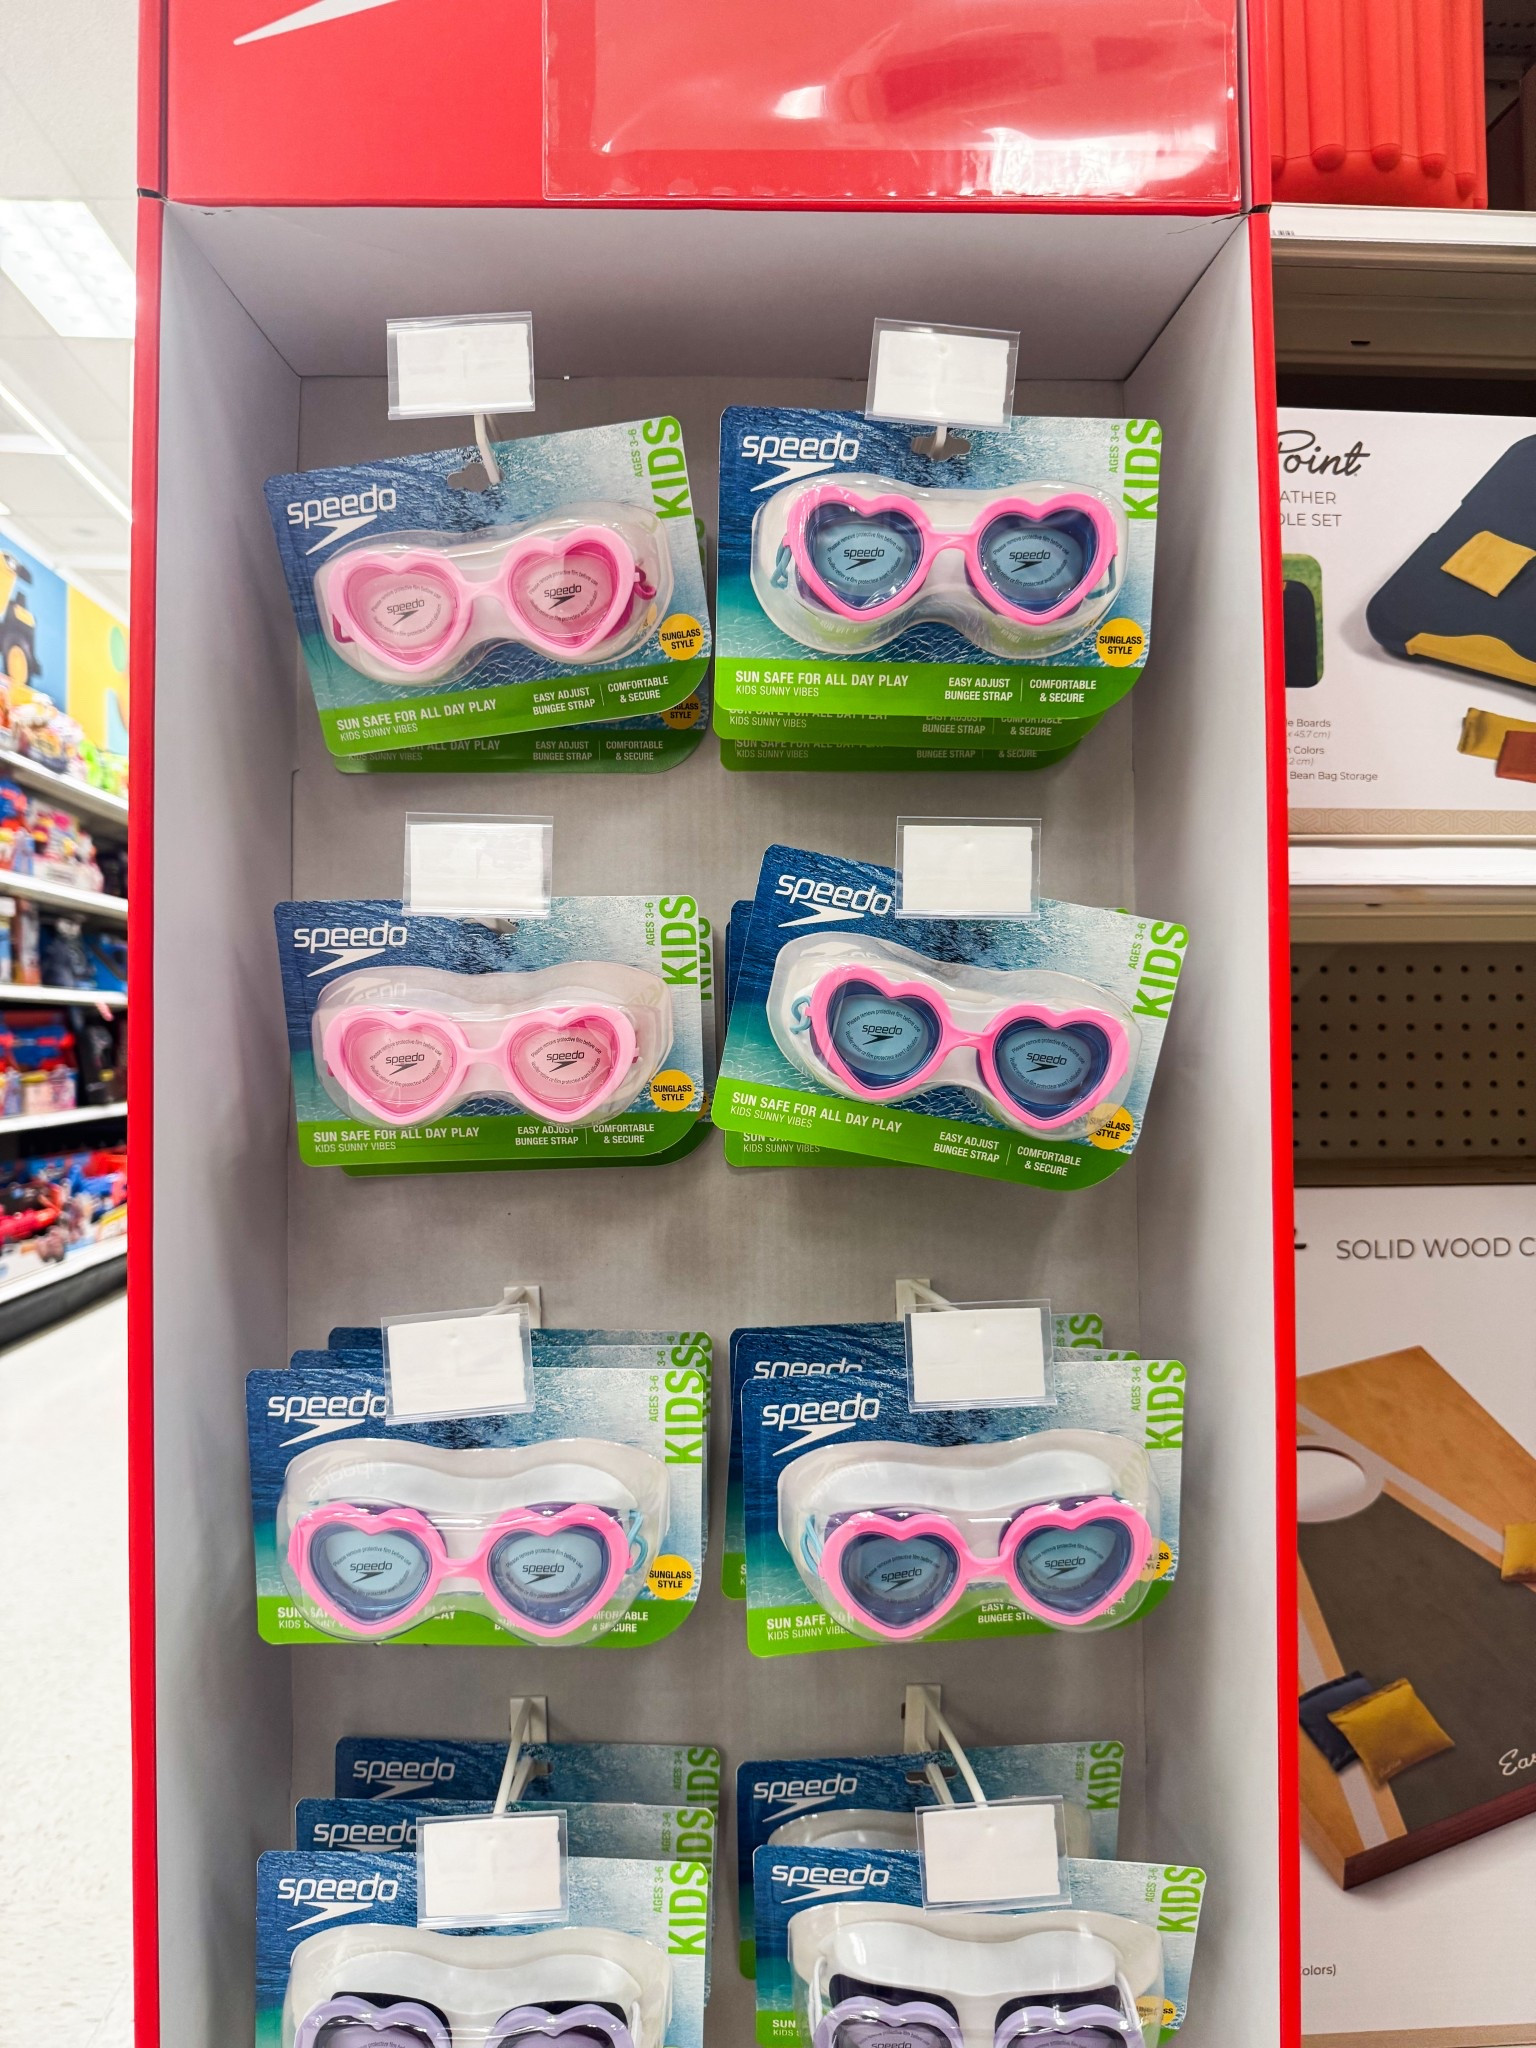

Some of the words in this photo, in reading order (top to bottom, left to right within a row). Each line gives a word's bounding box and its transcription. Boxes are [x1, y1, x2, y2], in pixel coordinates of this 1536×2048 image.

[628, 428, 640, 447] 3-6
[1111, 424, 1120, 442] 3-6
[741, 431, 860, 465] speedo
[629, 451, 644, 477] AGES
[643, 416, 692, 519] KIDS
[1109, 446, 1118, 473] AGES
[1123, 419, 1162, 519] KIDS
[1280, 490, 1336, 504] ATHER
[287, 483, 396, 529] speedo
[1311, 514, 1342, 527] SET
[843, 547, 885, 559] speedo
[1009, 549, 1051, 562] speedo
[544, 584, 582, 598] speedo
[387, 598, 425, 615] speedo
[661, 628, 701, 641] SUNGLASS
[1099, 636, 1141, 645] SUNGLASS
[671, 639, 694, 650] STYLE
[1107, 646, 1133, 655] STYLE
[608, 676, 668, 692] COMFORTABLE
[736, 671, 759, 683] SUN
[764, 672, 793, 683] SAFE
[798, 673, 820, 684] FOR
[825, 674, 847, 685] ALL
[851, 674, 875, 686] DAY
[879, 675, 909, 687] PLAY
[949, 677, 972, 687] EASY
[975, 679, 1010, 688] ADJUST
[1030, 679, 1096, 689] COMFORTABLE
[533, 692, 556, 703] EASY
[558, 687, 589, 700] ADJUST
[620, 695, 626, 703] &
[629, 689, 661, 702] SECURE
[736, 686, 757, 695] KIDS
[760, 686, 790, 696] SUNNY
[793, 687, 819, 696] VIBES
[945, 691, 980, 700] BUNGEE
[983, 692, 1013, 701] STRAP
[1040, 693, 1046, 702] &
[1049, 693, 1084, 702] SECURE
[336, 718, 359, 731] SUN
[362, 713, 392, 727] SAFE
[395, 710, 416, 723] FOR
[420, 707, 441, 720] ALL
[444, 703, 465, 717] DAY
[469, 699, 497, 712] PLAY
[533, 704, 566, 715] BUNGEE
[568, 699, 595, 711] STRAP
[1297, 719, 1331, 728] Boards
[341, 730, 360, 742] KIDS
[363, 727, 391, 739] SUNNY
[394, 723, 418, 734] VIBES
[1294, 746, 1325, 754] Colors
[1290, 771, 1315, 780] Bean
[1318, 771, 1337, 782] Bag
[1340, 771, 1378, 782] Storage
[775, 874, 893, 915] speedo
[645, 902, 654, 919] 3-6
[294, 920, 407, 954] speedo
[645, 923, 655, 946] AGES
[659, 896, 698, 985] KIDS
[1128, 943, 1141, 969] AGES
[1135, 923, 1146, 941] 3-6
[1132, 921, 1189, 1019] KIDS
[862, 1024, 903, 1035] speedo
[386, 1052, 425, 1065] speedo
[546, 1050, 585, 1062] speedo
[1026, 1052, 1067, 1065] speedo
[661, 1093, 684, 1101] STYLE
[730, 1106, 751, 1118] KIDS
[754, 1110, 785, 1123] SUNNY
[787, 1116, 813, 1128] VIBES
[733, 1092, 757, 1106] SUN
[760, 1098, 790, 1113] SAFE
[793, 1104, 816, 1117] FOR
[819, 1108, 841, 1122] ALL
[845, 1113, 869, 1127] DAY
[872, 1118, 902, 1133] PLAY
[314, 1132, 337, 1142] SUN
[341, 1131, 370, 1141] SAFE
[374, 1130, 396, 1140] FOR
[400, 1128, 421, 1139] ALL
[426, 1128, 447, 1138] DAY
[452, 1127, 479, 1138] PLAY
[518, 1126, 540, 1135] EASY
[542, 1126, 574, 1134] ADJUST
[593, 1124, 654, 1133] COMFORTABLE
[1096, 1129, 1120, 1139] STYLE
[515, 1137, 548, 1145] BUNGEE
[613, 1135, 644, 1143] SECURE
[940, 1132, 962, 1144] EASY
[964, 1137, 999, 1150] ADJUST
[315, 1144, 336, 1153] KIDS
[339, 1142, 368, 1152] SUNNY
[371, 1142, 396, 1150] VIBES
[744, 1144, 763, 1152] KIDS
[765, 1144, 794, 1153] SUNNY
[796, 1144, 820, 1153] VIBES
[934, 1143, 968, 1158] BUNGEE
[970, 1150, 1000, 1163] STRAP
[1017, 1146, 1081, 1166] COMFORTABLE
[1025, 1161, 1031, 1170] &
[1033, 1162, 1068, 1176] SECURE
[1336, 1239, 1415, 1259] SOLID
[1422, 1237, 1511, 1258] WOOD
[1519, 1237, 1536, 1256] C
[1132, 1366, 1141, 1382] 3-6
[650, 1375, 659, 1392] 3-6
[267, 1389, 388, 1424] speedo
[1131, 1386, 1141, 1411] AGES
[1145, 1361, 1187, 1449] KIDS
[649, 1396, 659, 1422] AGES
[664, 1369, 704, 1463] KIDS
[762, 1392, 880, 1431] speedo
[350, 1561, 392, 1573] speedo
[522, 1563, 565, 1574] speedo
[1044, 1556, 1086, 1569] speedo
[649, 1570, 692, 1579] SUNGLASS
[881, 1567, 922, 1582] speedo
[658, 1580, 683, 1588] STYLE
[279, 1620, 300, 1628] KIDS
[767, 1618, 791, 1630] SUN
[796, 1614, 826, 1627] SAFE
[978, 1613, 1013, 1623] BUNGEE
[768, 1630, 789, 1640] KIDS
[792, 1628, 822, 1638] SUNNY
[353, 1756, 455, 1784] speedo
[1086, 1741, 1124, 1810] KIDS
[753, 1773, 857, 1803] speedo
[654, 1866, 664, 1884] 3-6
[771, 1864, 890, 1886] speedo
[277, 1872, 399, 1906] speedo
[1144, 1884, 1156, 1903] AGES
[653, 1887, 663, 1913] AGES
[1156, 1865, 1206, 1933] KIDS
[668, 1862, 708, 1955] KIDS
[1301, 1964, 1337, 1977] olors)
[772, 2020, 796, 2028] SUN
